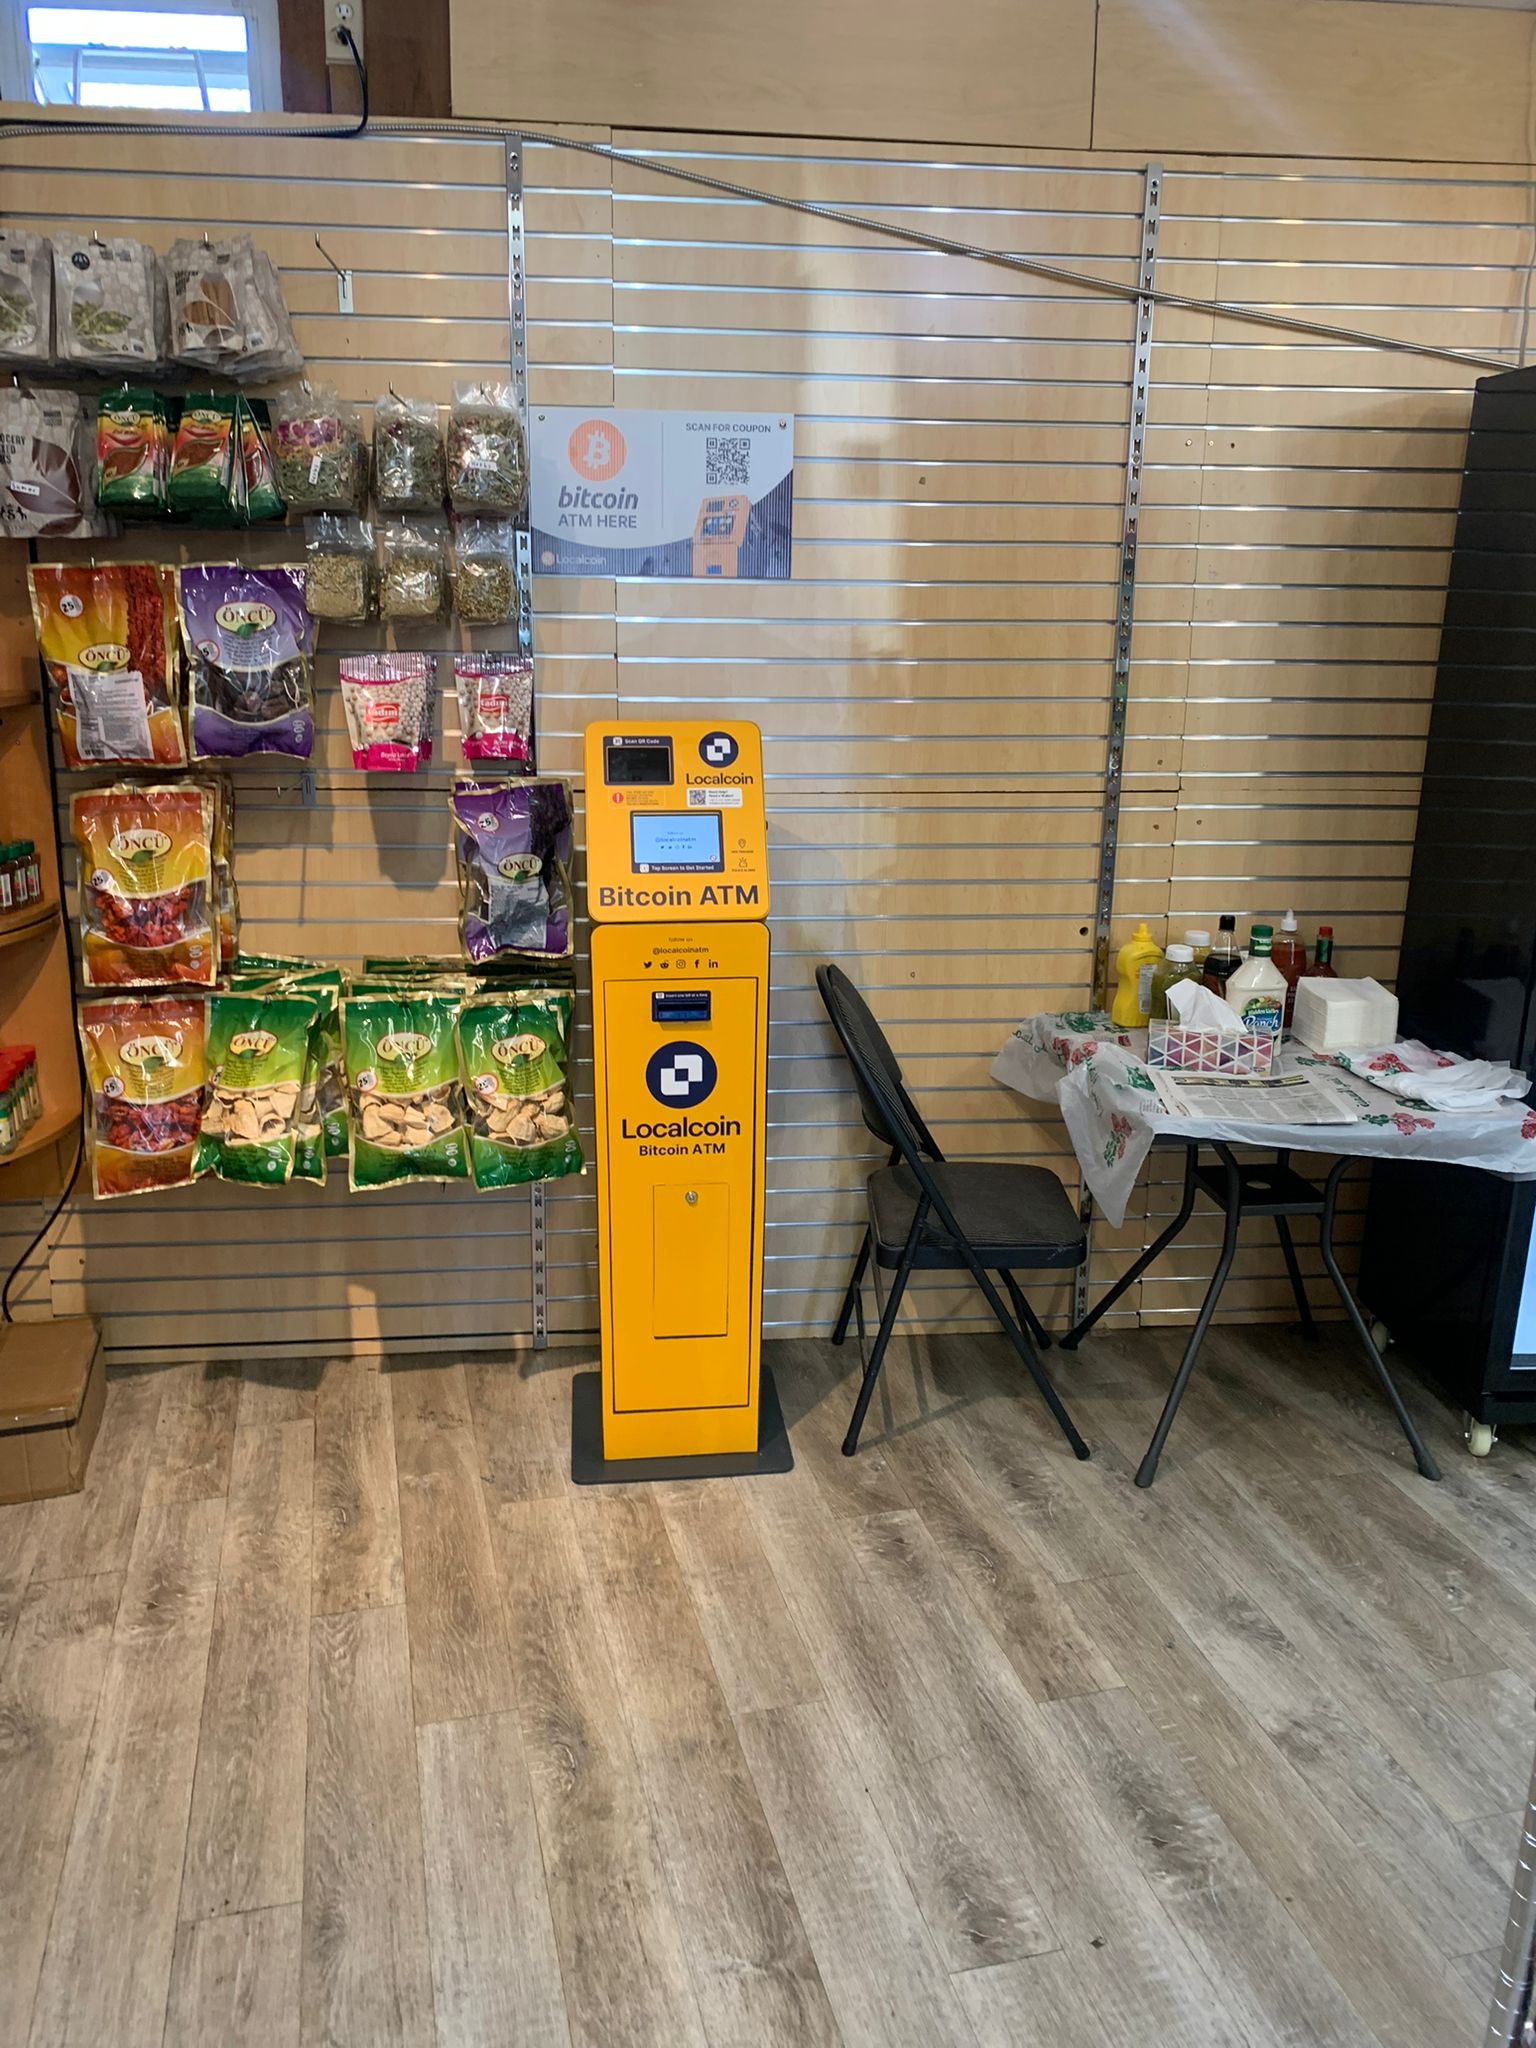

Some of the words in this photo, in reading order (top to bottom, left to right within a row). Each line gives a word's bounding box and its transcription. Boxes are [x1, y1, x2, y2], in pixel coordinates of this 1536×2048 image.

[685, 423, 711, 432] SCAN
[712, 423, 731, 432] FOR
[732, 423, 772, 433] COUPON
[558, 485, 639, 510] bitcoin
[558, 514, 592, 528] ATM
[597, 515, 637, 529] HERE
[555, 554, 607, 566] Localcoin
[222, 605, 270, 623] ÖNCÜ
[85, 647, 128, 662] ÖNCÜ
[686, 772, 754, 785] Localcoin
[503, 858, 538, 871] ÖNCÜ
[599, 886, 692, 907] Bitcoin
[699, 885, 759, 906] ATM
[652, 946, 709, 956] @localcoinatm
[1242, 1013, 1279, 1028] Ranch
[497, 1038, 540, 1057] ÖNCÜ
[621, 1115, 741, 1139] Localcoin
[638, 1143, 689, 1157] Bitcoin
[692, 1142, 726, 1154] ATM
